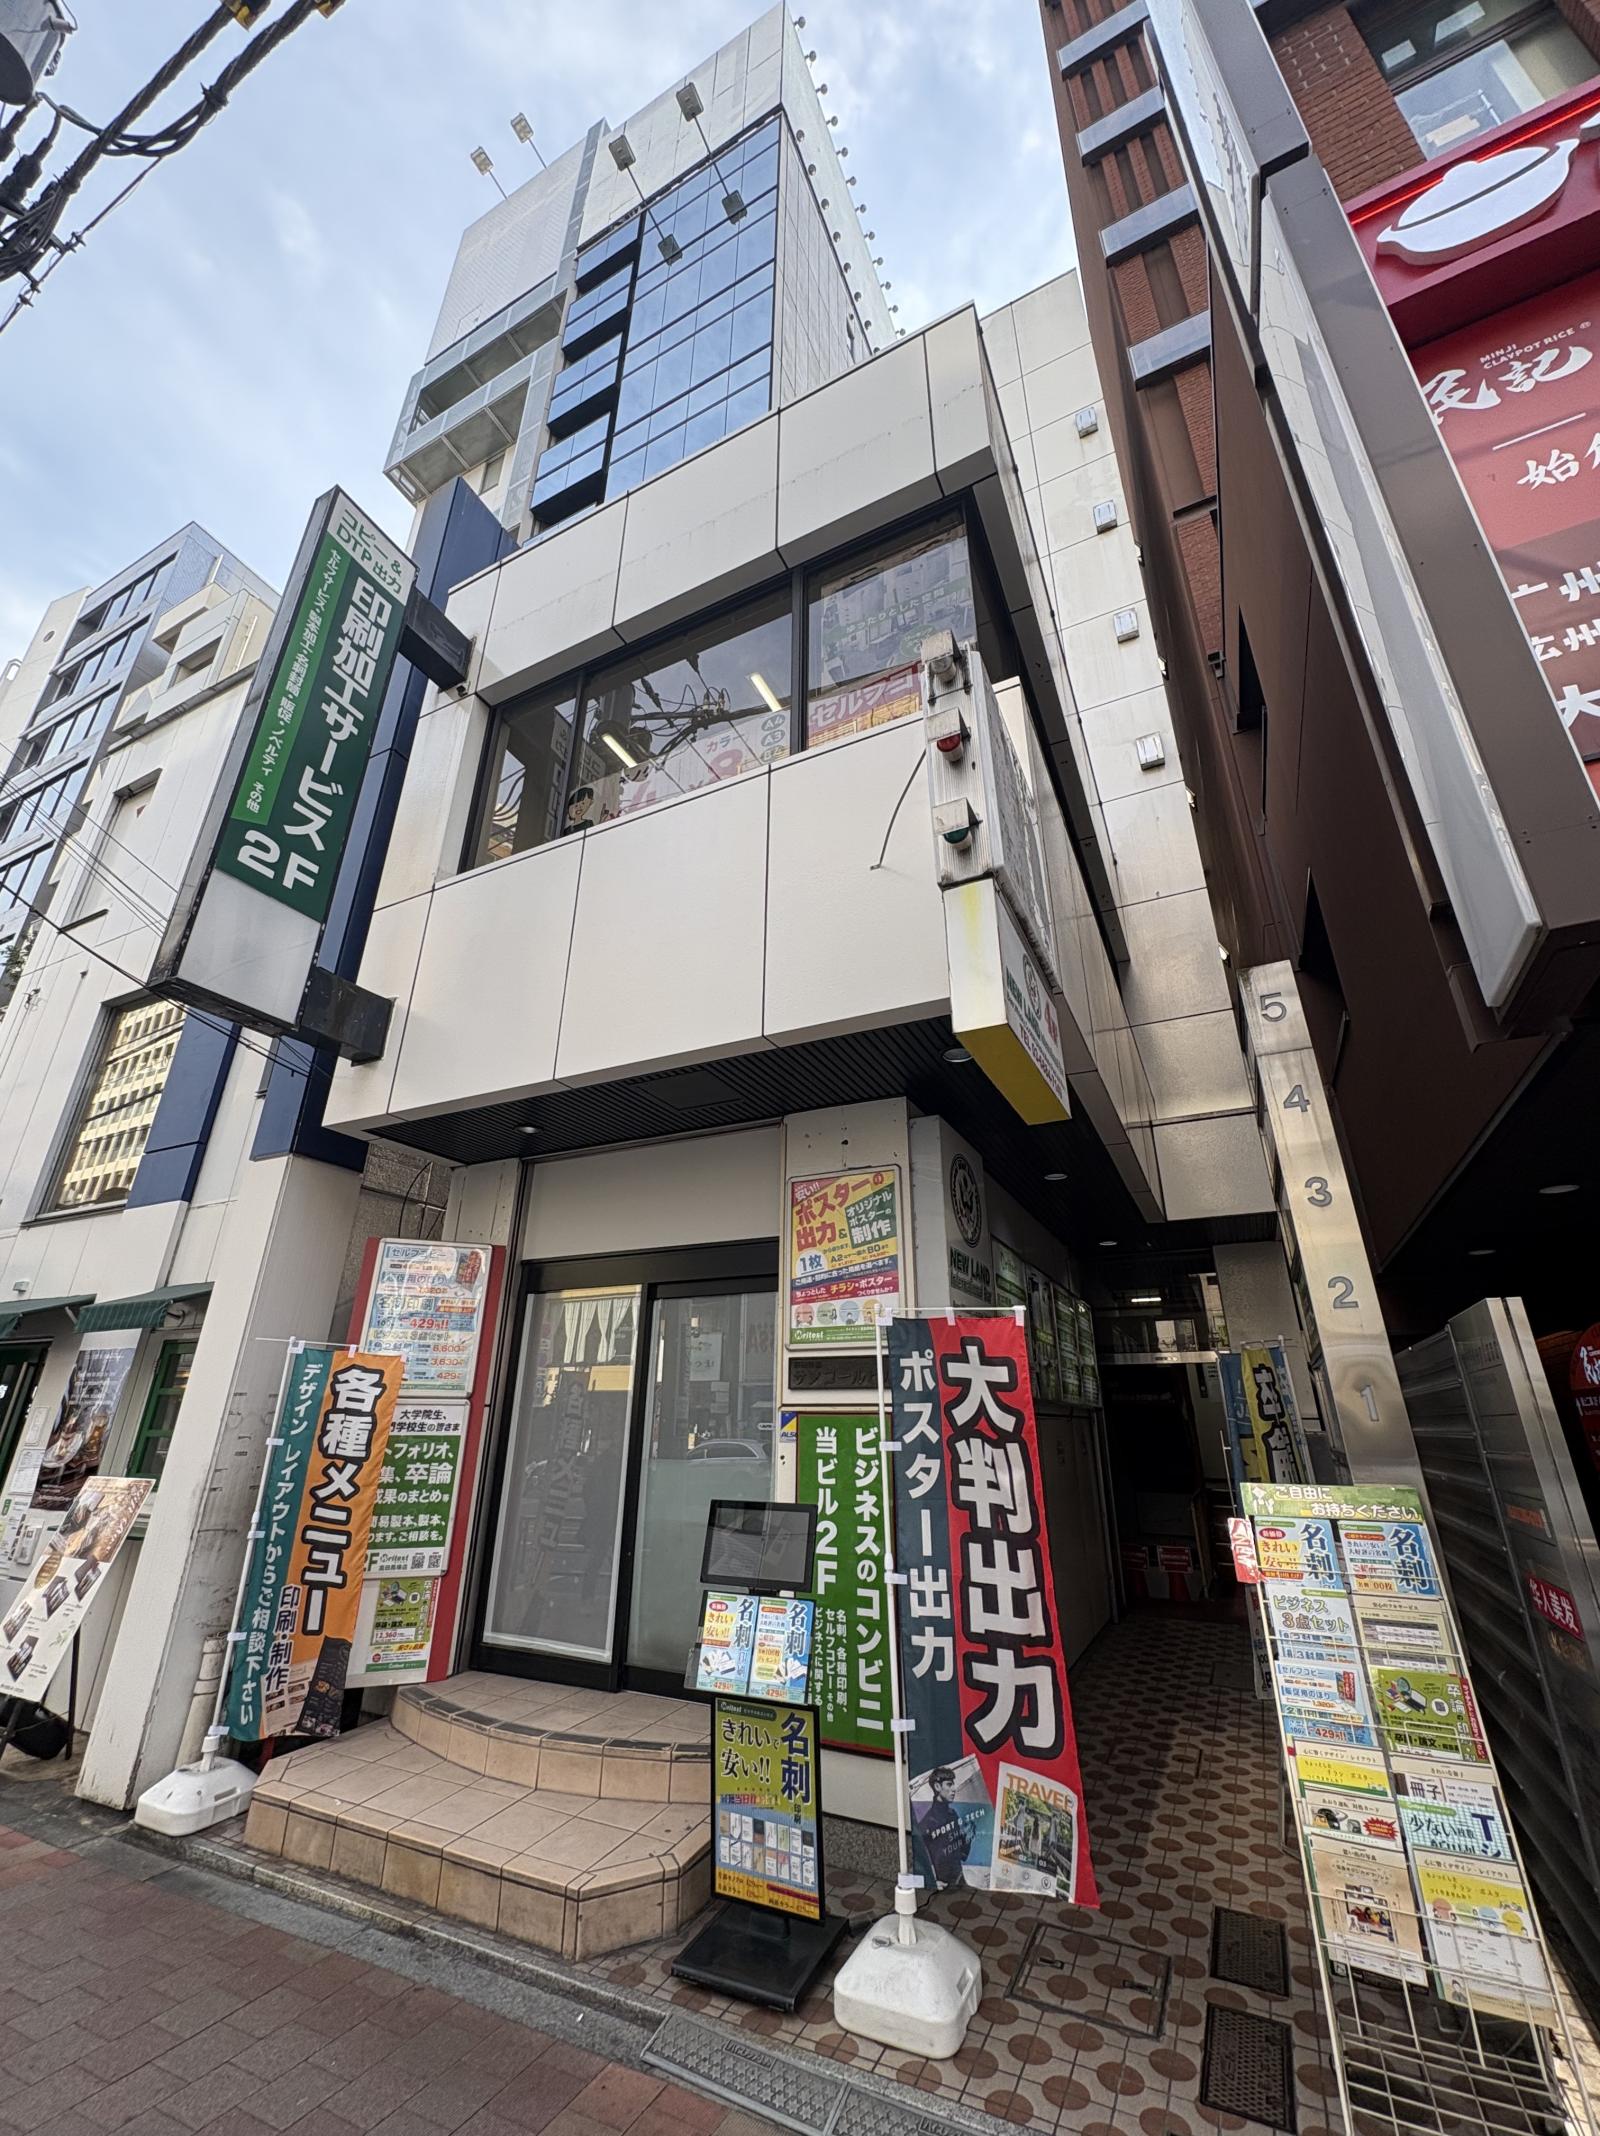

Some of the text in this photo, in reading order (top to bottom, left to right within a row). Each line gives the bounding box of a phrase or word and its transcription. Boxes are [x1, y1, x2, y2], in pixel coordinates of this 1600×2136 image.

[1479, 343, 1518, 364] MINJI
[1483, 327, 1576, 370] CLAYPOT RICE
[336, 522, 402, 594] DTP 出力
[341, 508, 402, 577] コピー &
[283, 575, 393, 852] 印刷加工サービス
[764, 714, 784, 731] A4
[763, 731, 783, 745] A3
[246, 780, 266, 814] その他
[236, 829, 320, 891] 2F
[1260, 992, 1288, 1023] 5
[1283, 1084, 1311, 1113] 4
[795, 1172, 885, 1227] ポスターの
[846, 1190, 892, 1218] オリジナル
[1304, 1176, 1333, 1208] 3
[848, 1208, 892, 1227] ポスターの
[850, 1219, 892, 1245] 制作
[796, 1221, 848, 1252] 出力 &
[799, 1253, 823, 1272] 1枚
[950, 1246, 970, 1274] NEW
[970, 1257, 991, 1286] LAND
[796, 1276, 893, 1298] ちょっとした チラシ・ポスター
[1327, 1276, 1359, 1309] 2
[400, 1409, 447, 1420] 大学院生、
[1359, 1383, 1380, 1422] 1
[302, 1367, 384, 1633] 各種メニュー
[814, 1425, 838, 1596] 当ビル2F
[1274, 1485, 1334, 1501] ご自由に
[1311, 1502, 1420, 1519] お持ちください
[899, 1349, 954, 1683] ポスター出力
[238, 1362, 322, 1726] デザイン レイアウトからご相談下さい
[946, 1344, 1056, 1749] 大判出力
[1261, 1540, 1298, 1553] きれい
[1300, 1523, 1335, 1581] 名刺
[1389, 1527, 1429, 1590] 名刺
[853, 1425, 884, 1732] ビジネスのコンビニ
[1272, 1594, 1329, 1613] ビジネス
[1281, 1611, 1350, 1633] 3点セット
[264, 1584, 301, 1694] 印刷・制作
[733, 1598, 754, 1649] 名刺
[785, 1603, 808, 1657] 名刺
[814, 1606, 824, 1706] ビジネスに関する
[825, 1608, 836, 1723] セルフコピー その他
[835, 1608, 848, 1713] 名刺、各種印刷、
[1282, 1666, 1324, 1676] セルフコピー
[720, 1748, 771, 1785] 安い!!
[780, 1711, 812, 1805] 名刺
[1410, 1781, 1442, 1800] 冊子
[931, 1823, 956, 1839] SPORT
[964, 1808, 986, 1823] TECH
